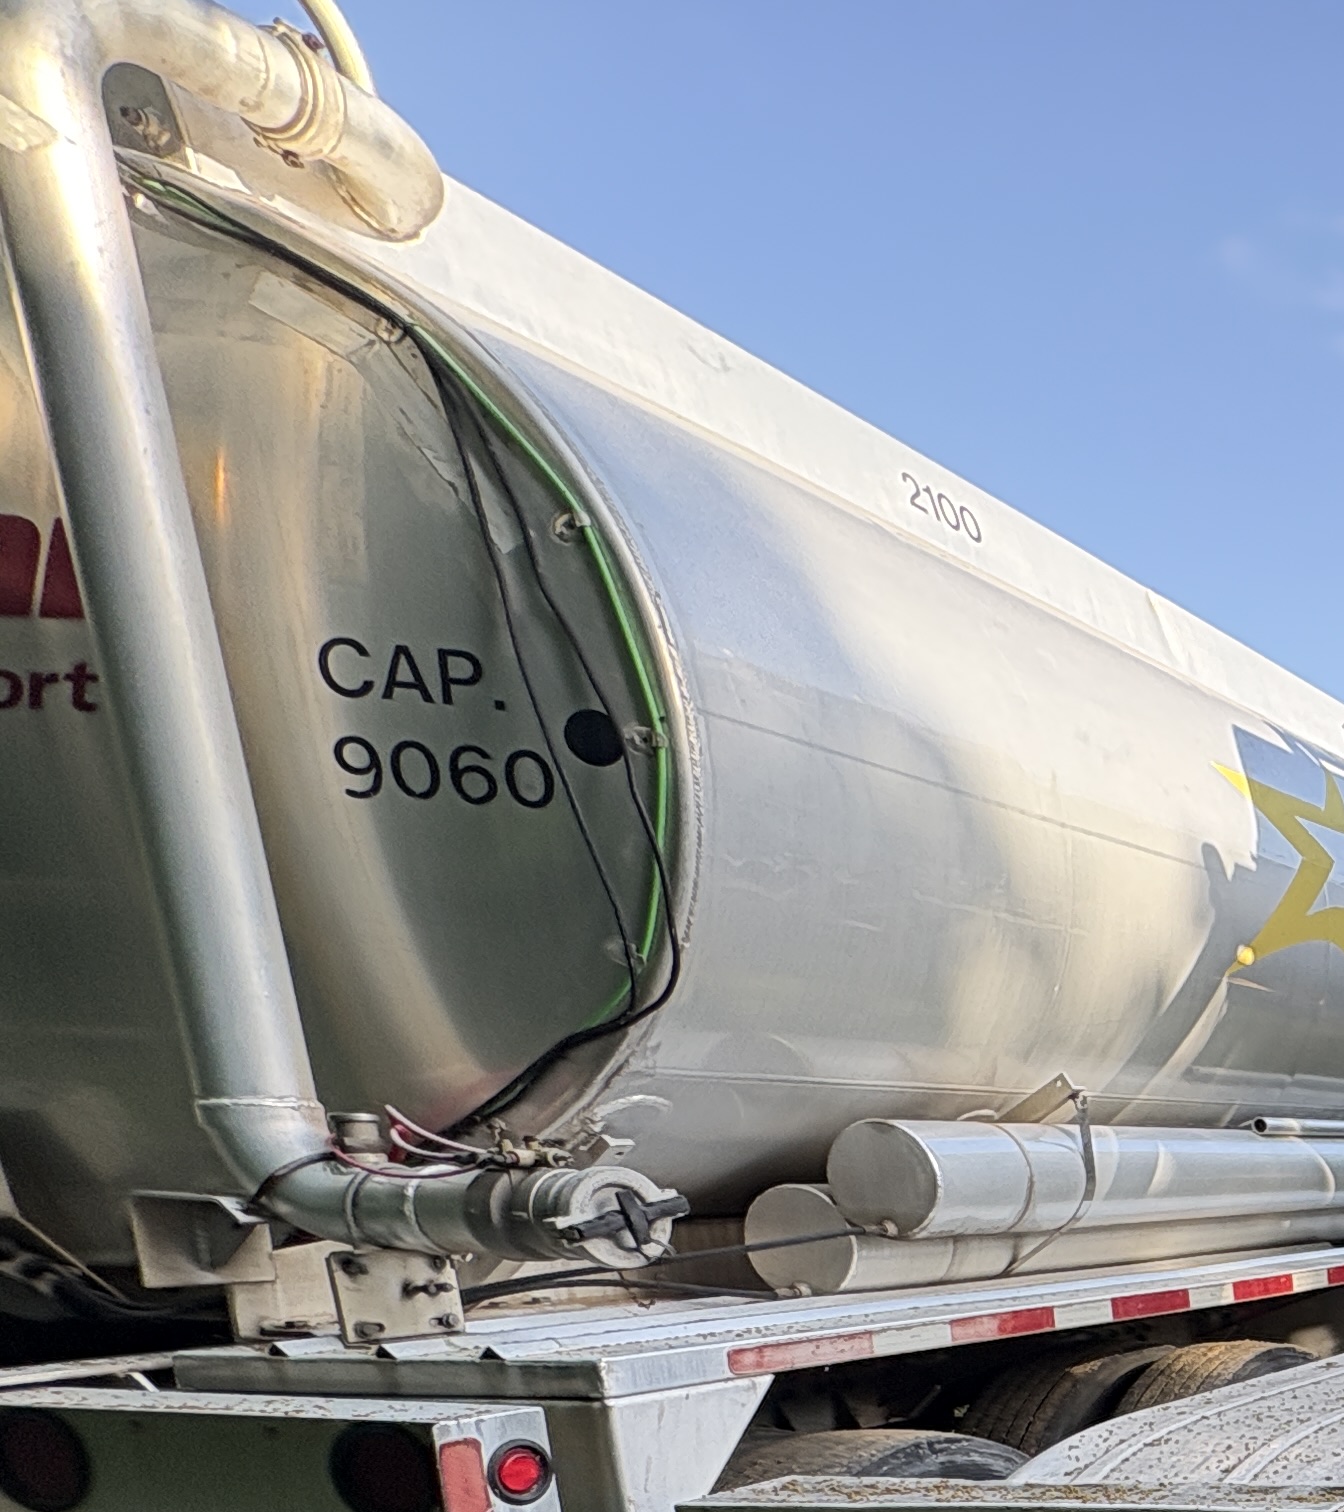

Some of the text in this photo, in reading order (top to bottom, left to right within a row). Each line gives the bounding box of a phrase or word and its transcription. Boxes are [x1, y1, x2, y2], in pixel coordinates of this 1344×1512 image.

[901, 472, 982, 543] 2100
[317, 636, 506, 711] CAP.
[332, 735, 556, 809] 9060
